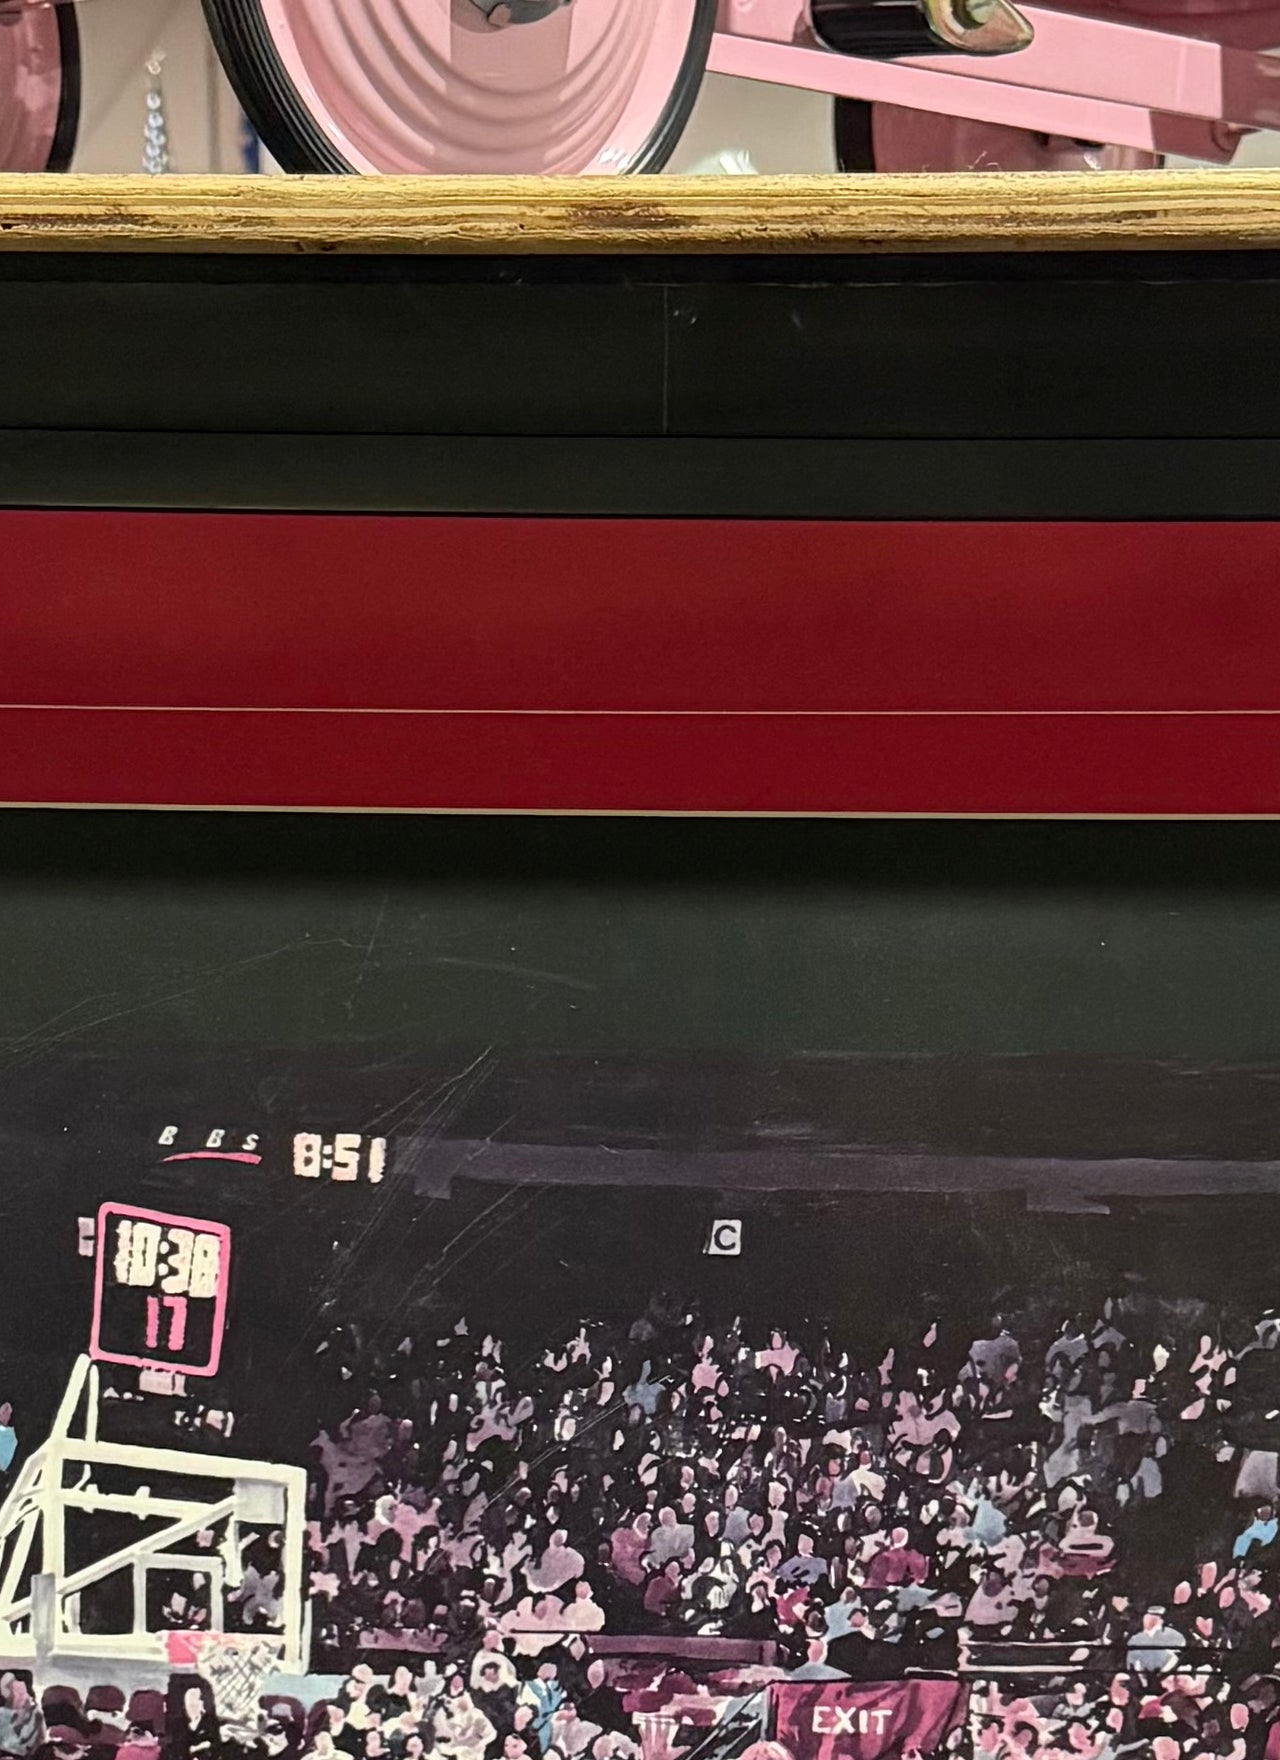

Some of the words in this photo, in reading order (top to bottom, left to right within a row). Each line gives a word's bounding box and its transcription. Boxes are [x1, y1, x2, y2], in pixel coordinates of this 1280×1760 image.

[290, 1132, 387, 1183] 8:51
[713, 1224, 736, 1250] C
[812, 1706, 893, 1735] EXIT
